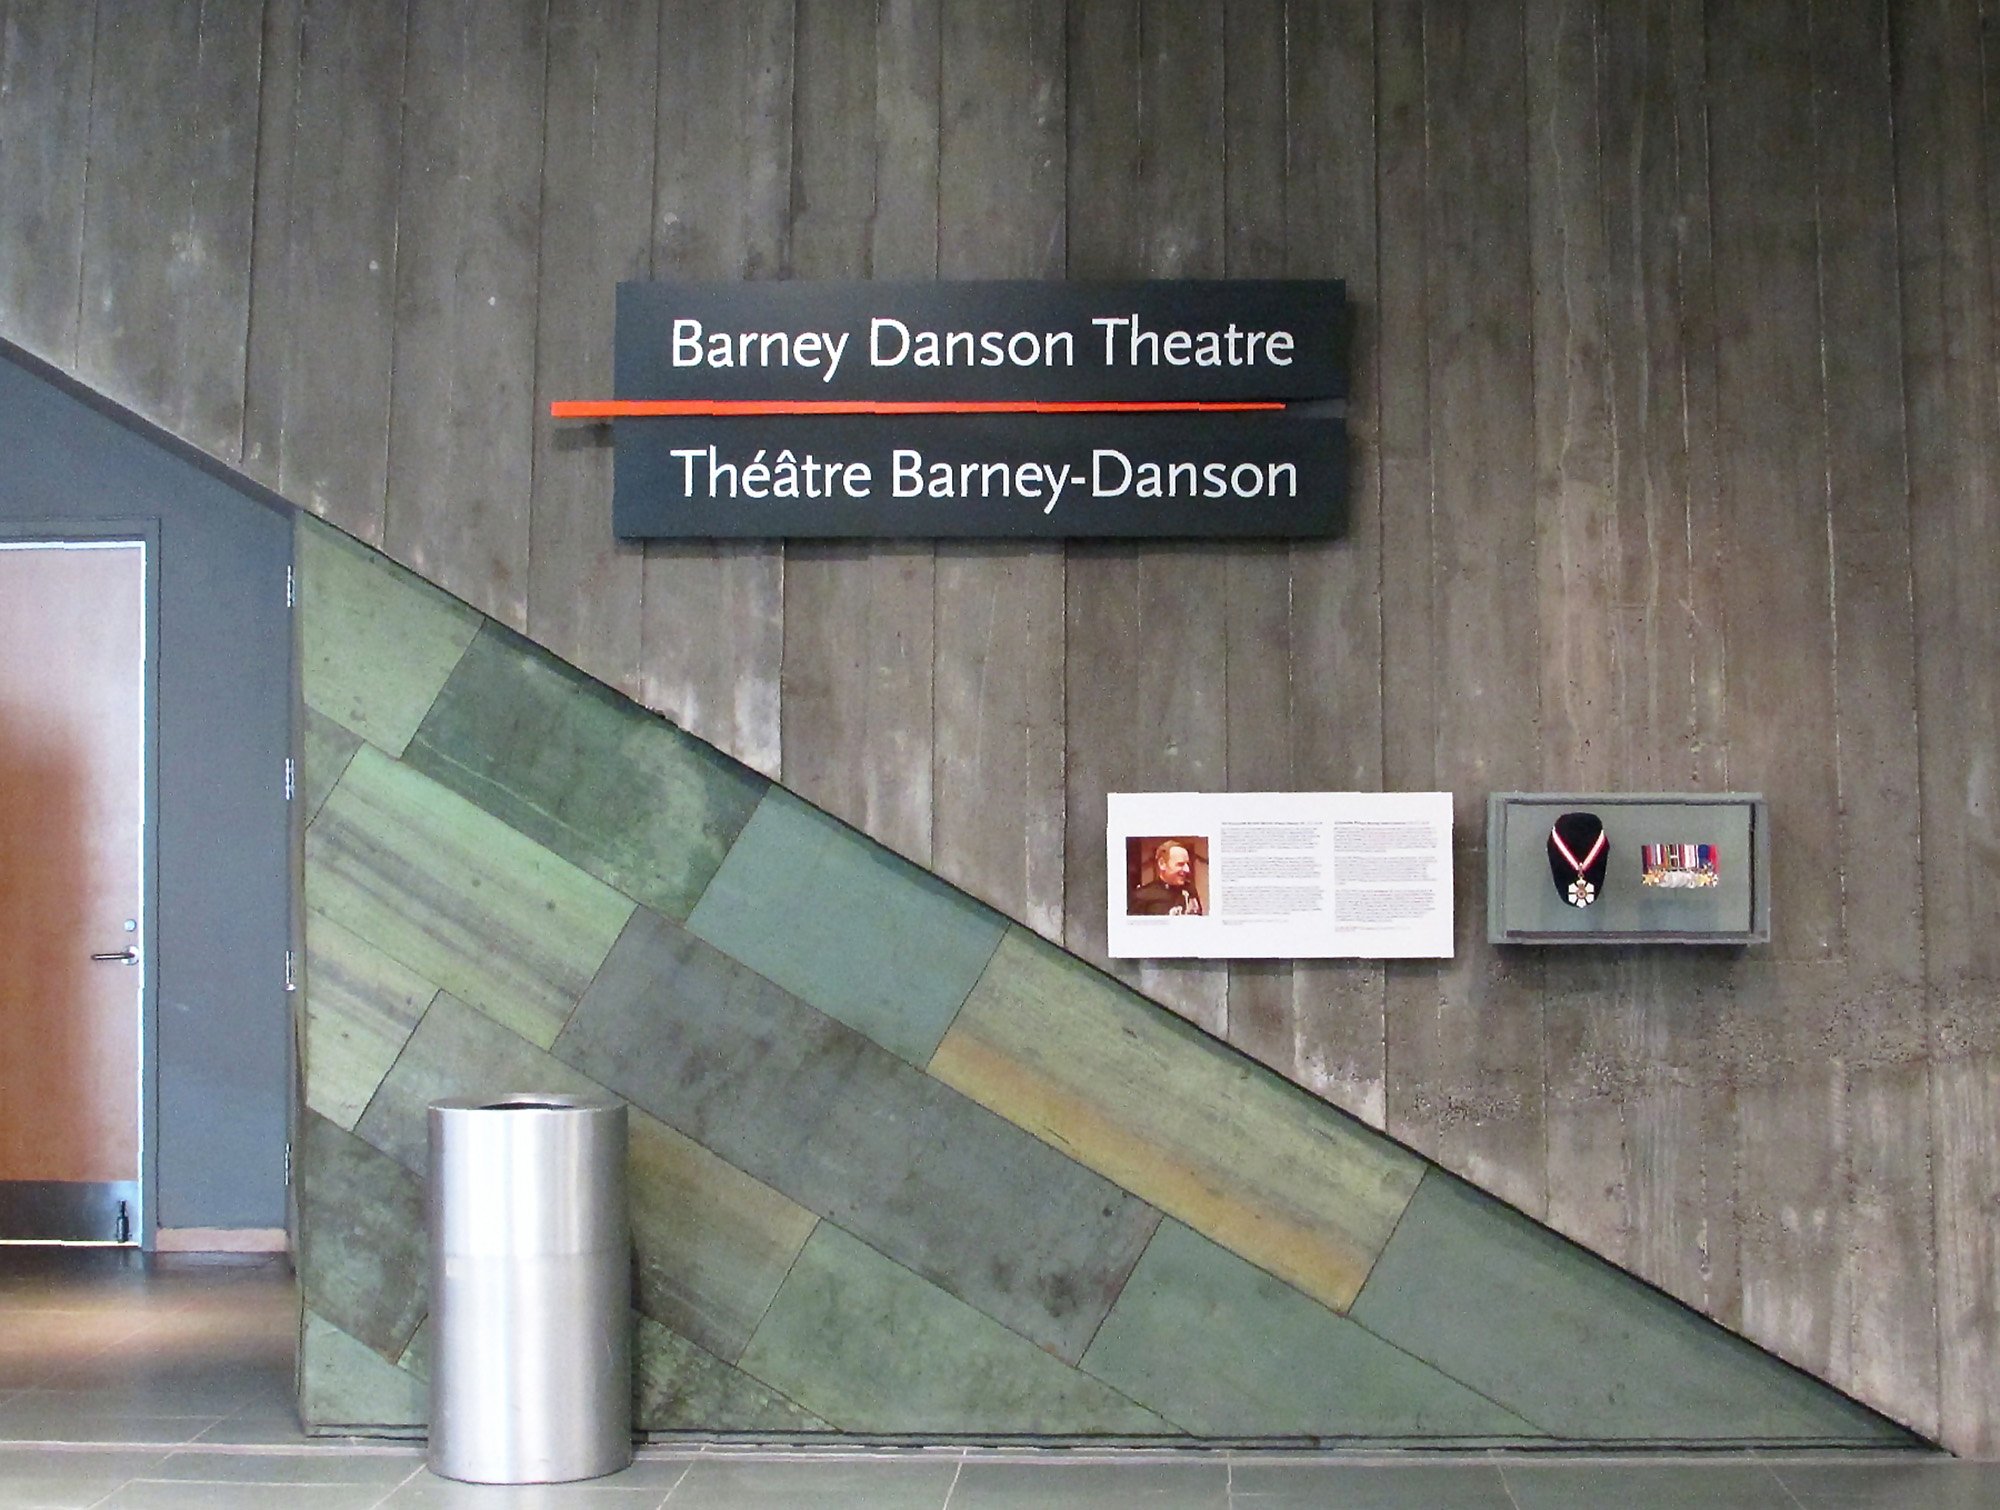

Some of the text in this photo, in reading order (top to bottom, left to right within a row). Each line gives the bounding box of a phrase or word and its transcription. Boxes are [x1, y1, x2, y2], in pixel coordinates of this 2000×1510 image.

[672, 313, 1295, 383] Barney Danson Theatre
[669, 444, 1297, 515] Théâtre Barney-Danson
